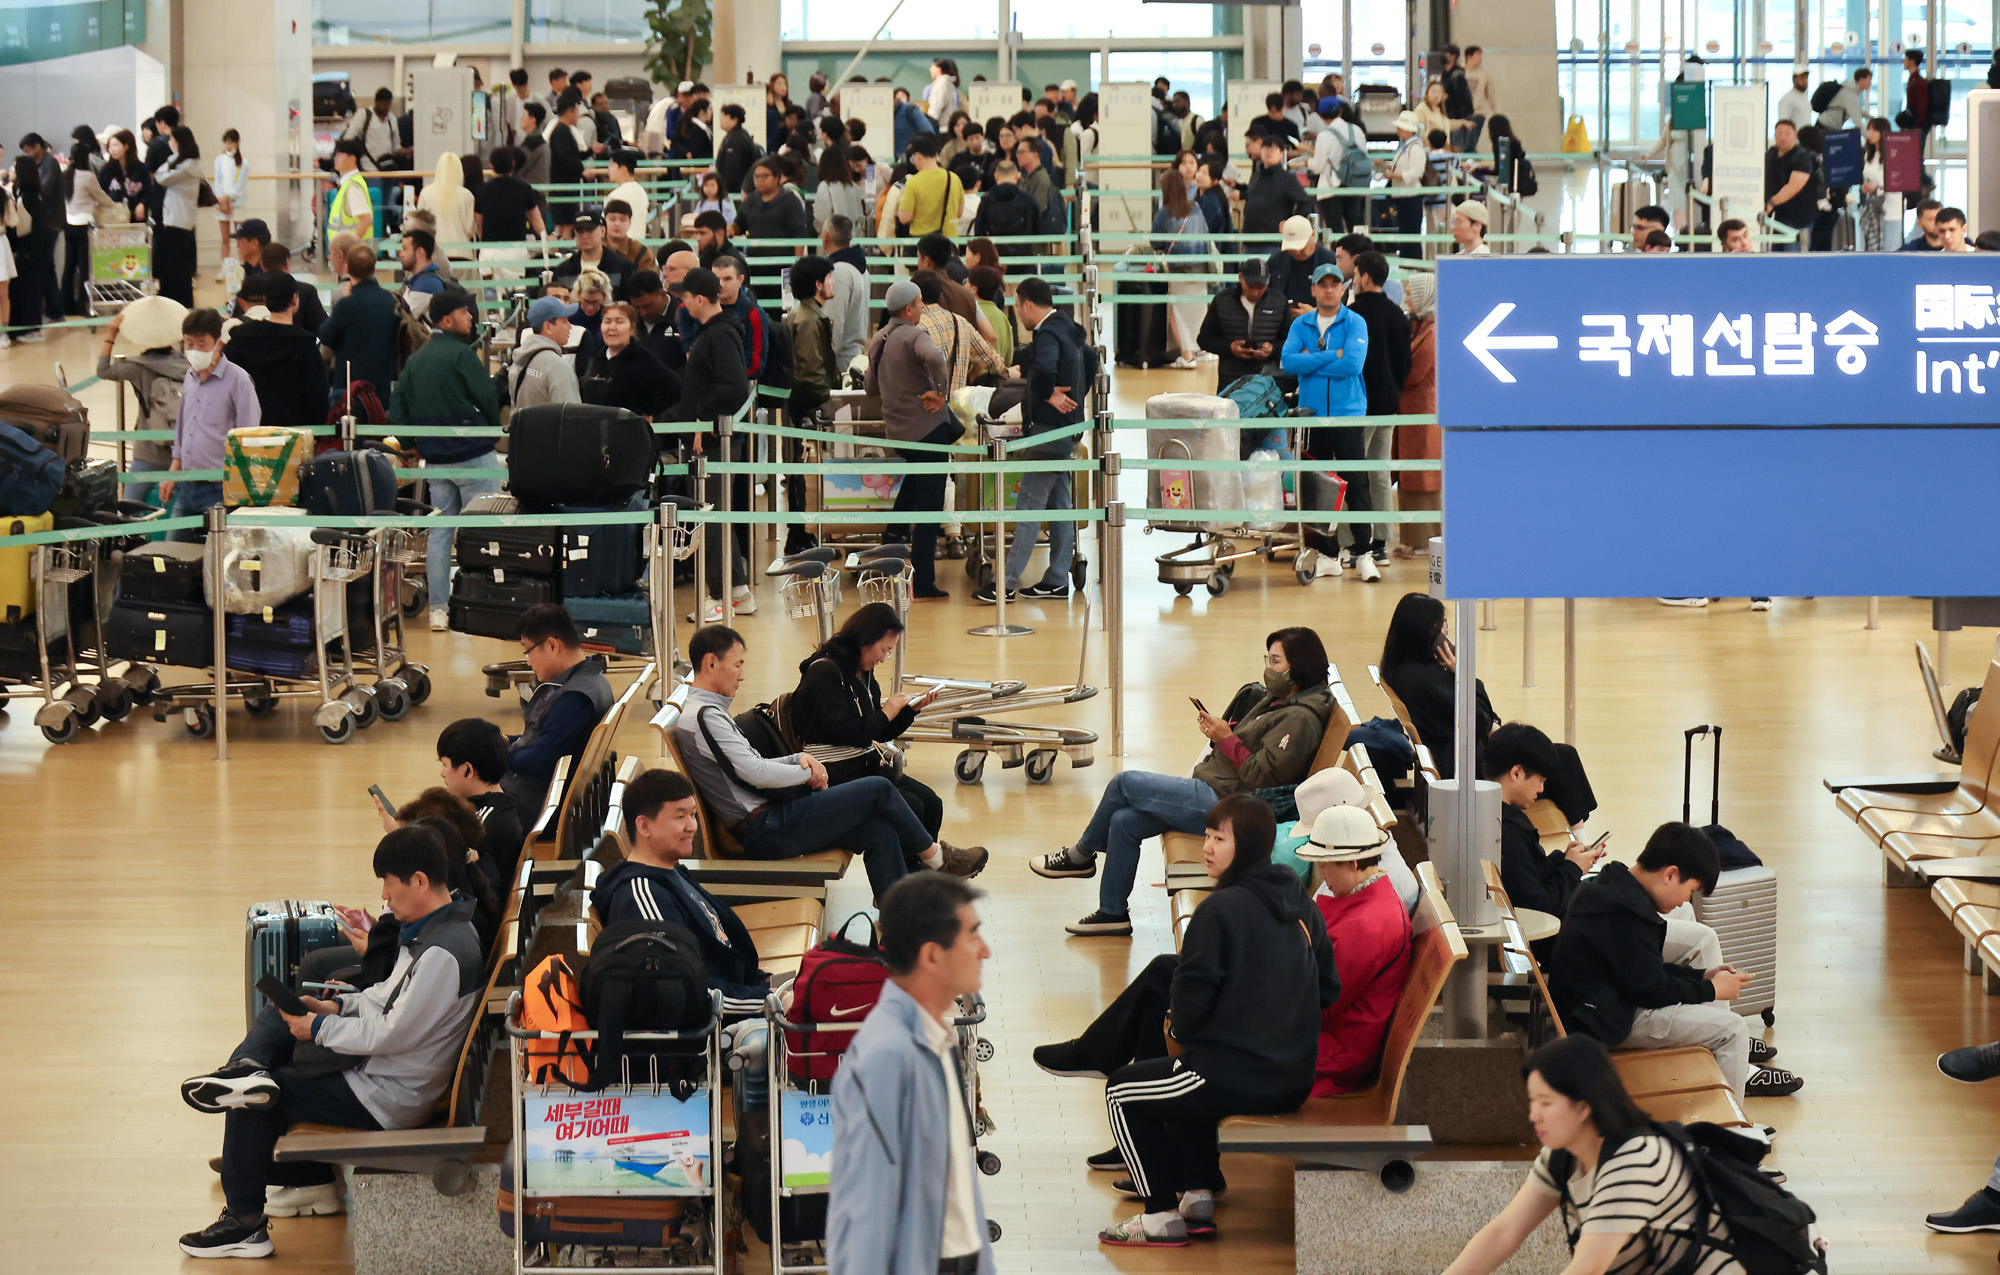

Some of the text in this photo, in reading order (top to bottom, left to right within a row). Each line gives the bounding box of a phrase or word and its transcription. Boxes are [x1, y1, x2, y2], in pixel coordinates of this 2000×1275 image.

[1916, 283, 2000, 331] 国际
[1578, 310, 1880, 378] 국제선탑승
[1429, 554, 1442, 568] GE
[1749, 1069, 1796, 1086] AIR
[555, 1114, 630, 1141] 여기어때
